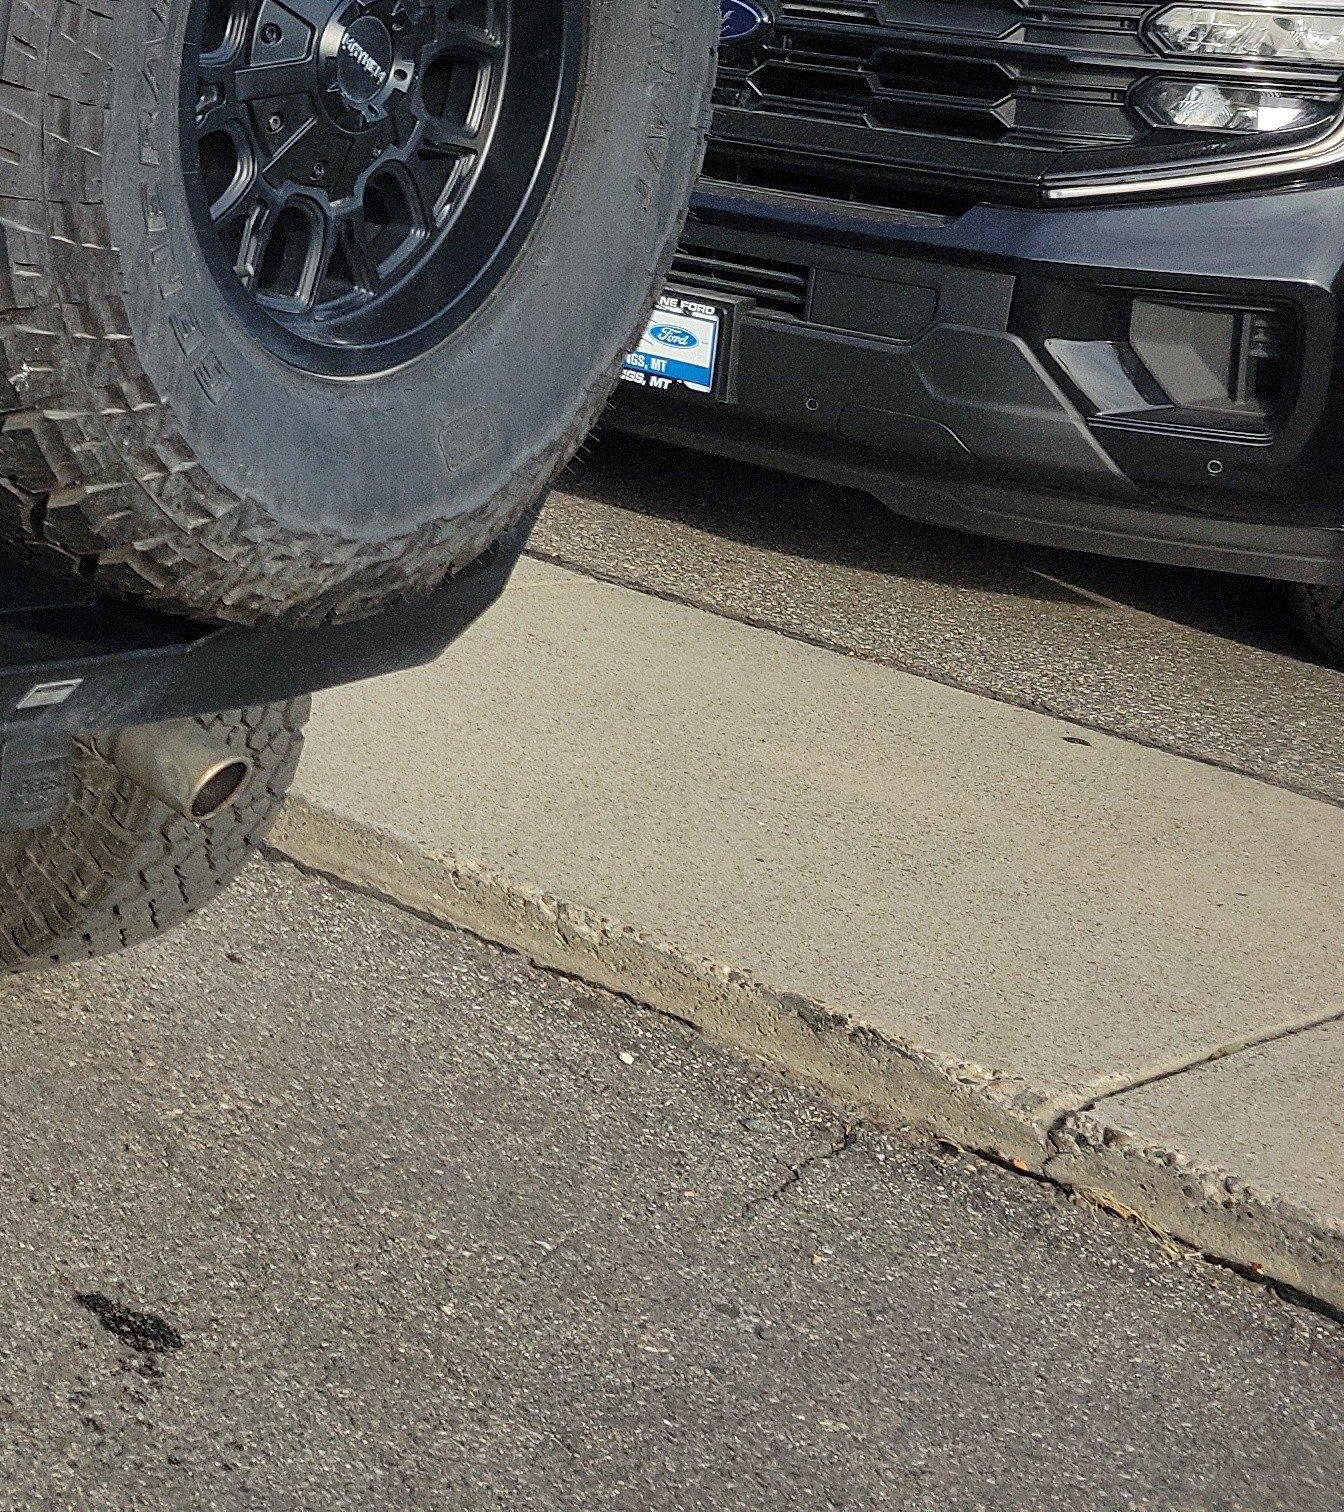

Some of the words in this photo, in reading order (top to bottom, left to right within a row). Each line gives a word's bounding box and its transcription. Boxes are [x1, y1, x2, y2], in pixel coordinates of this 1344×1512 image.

[680, 298, 715, 315] FORD
[657, 327, 688, 346] Ford
[650, 357, 668, 373] MT
[649, 375, 672, 390] MT
